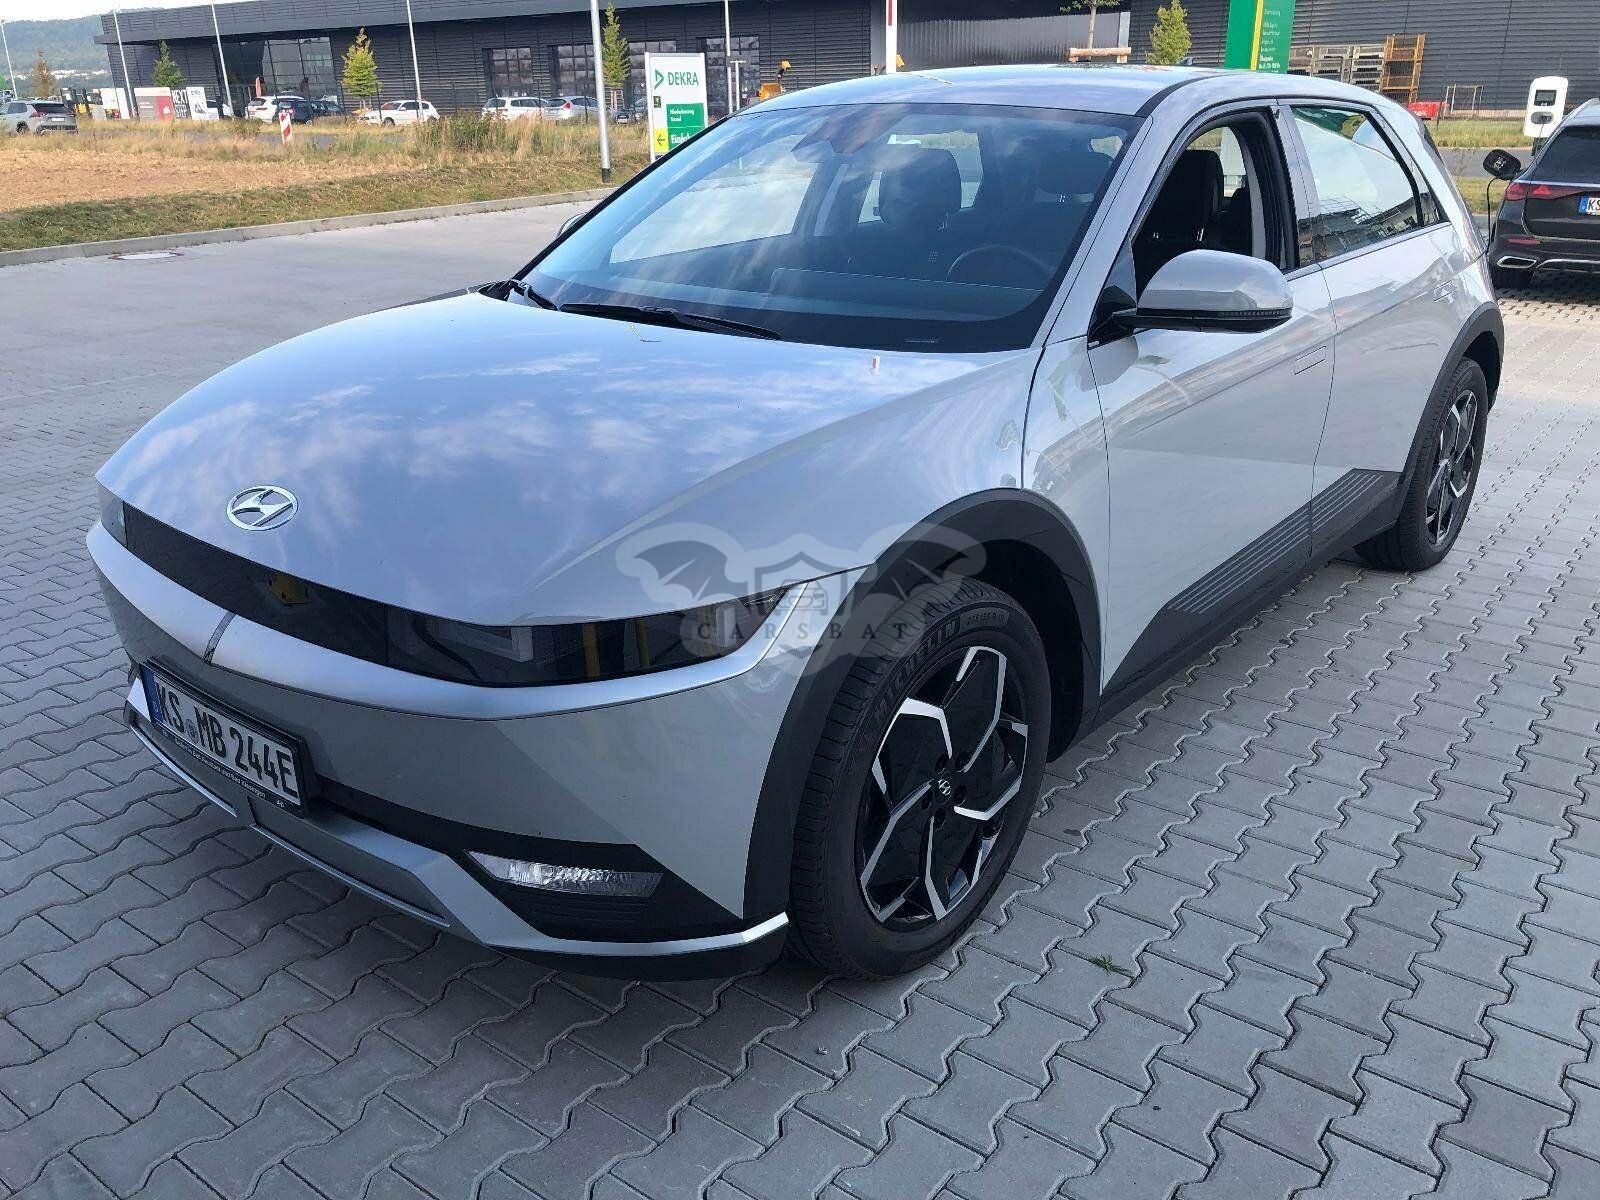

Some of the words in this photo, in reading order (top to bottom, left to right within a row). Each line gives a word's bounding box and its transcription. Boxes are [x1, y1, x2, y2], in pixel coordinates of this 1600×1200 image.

[667, 71, 699, 86] DEKRA
[171, 89, 188, 104] NEXT
[670, 132, 691, 144] Einfah
[155, 681, 184, 733] KS
[194, 705, 227, 759] MB
[229, 726, 299, 799] 244E
